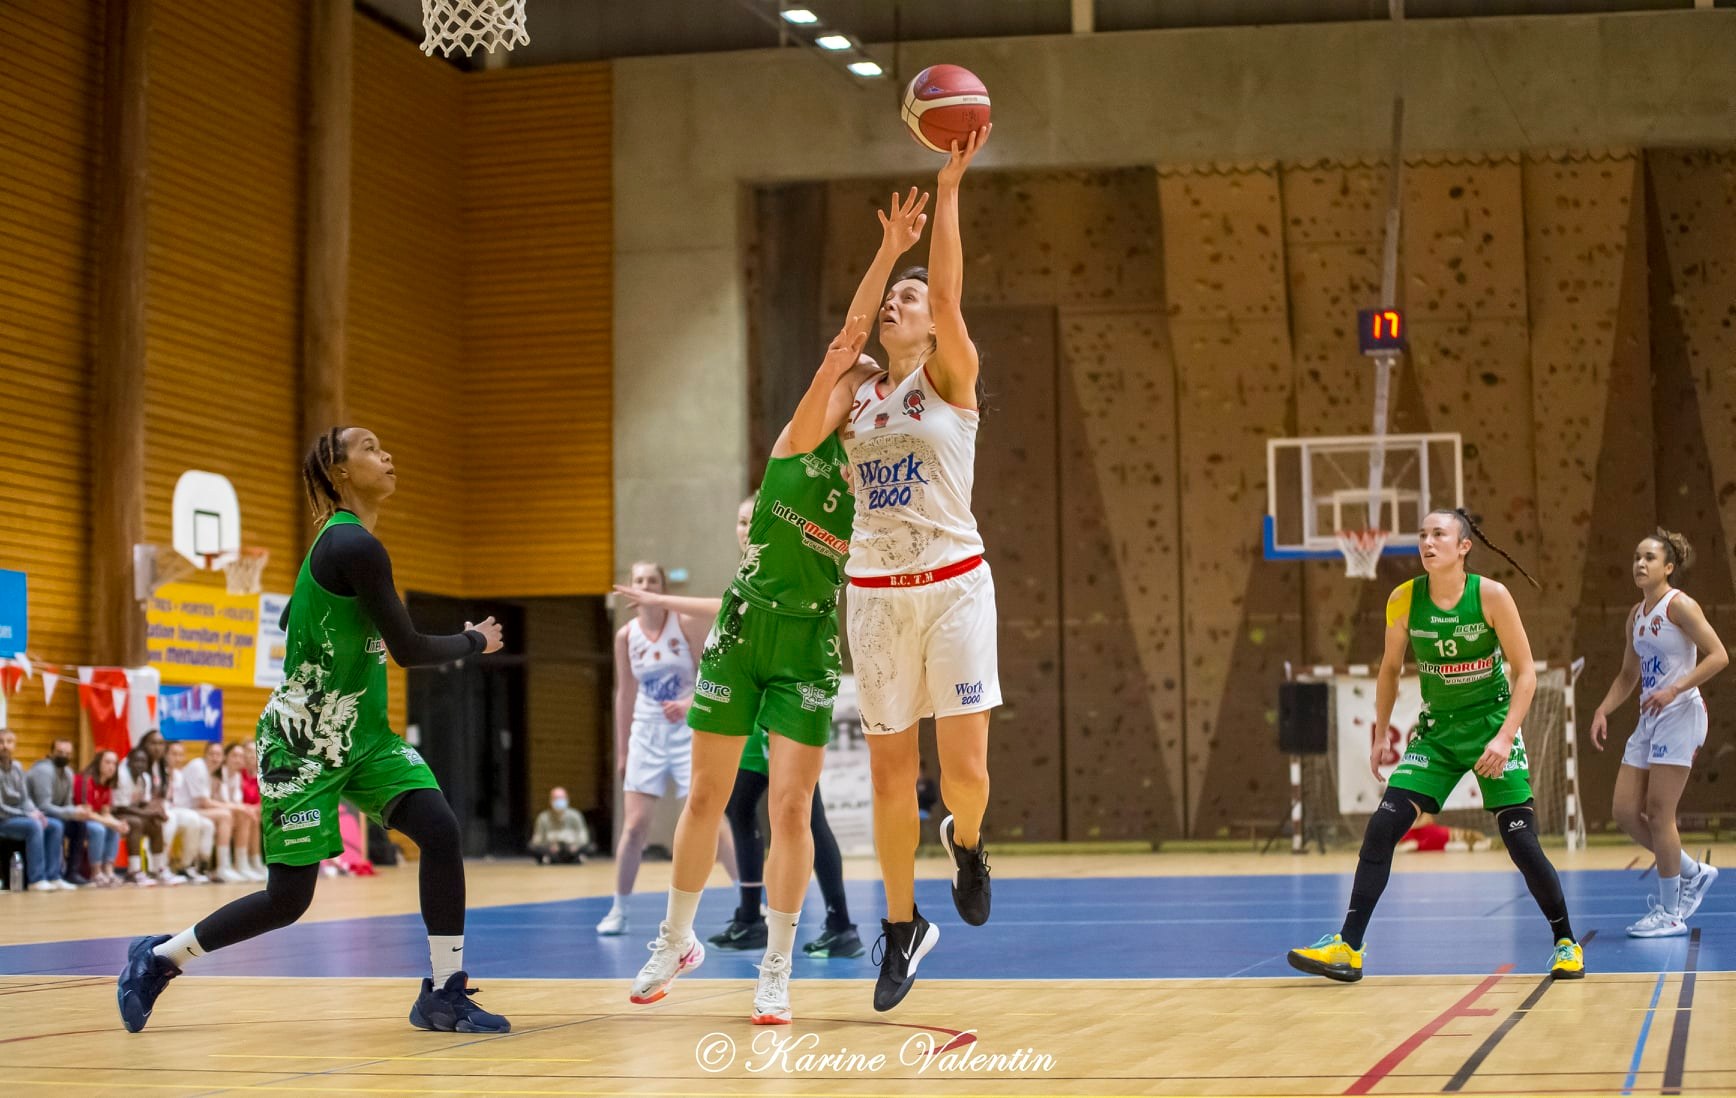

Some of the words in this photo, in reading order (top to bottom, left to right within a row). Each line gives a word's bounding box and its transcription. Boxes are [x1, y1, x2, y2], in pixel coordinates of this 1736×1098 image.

[1373, 311, 1400, 339] 17
[857, 451, 931, 487] Work
[823, 488, 841, 513] 5
[868, 486, 911, 510] 2000
[771, 500, 849, 556] Intermarch
[890, 575, 910, 586] B.C.
[1434, 639, 1458, 657] 13
[1641, 655, 1667, 677] ork
[955, 680, 984, 695] Work
[961, 694, 981, 705] 2000
[281, 808, 320, 827] Loire
